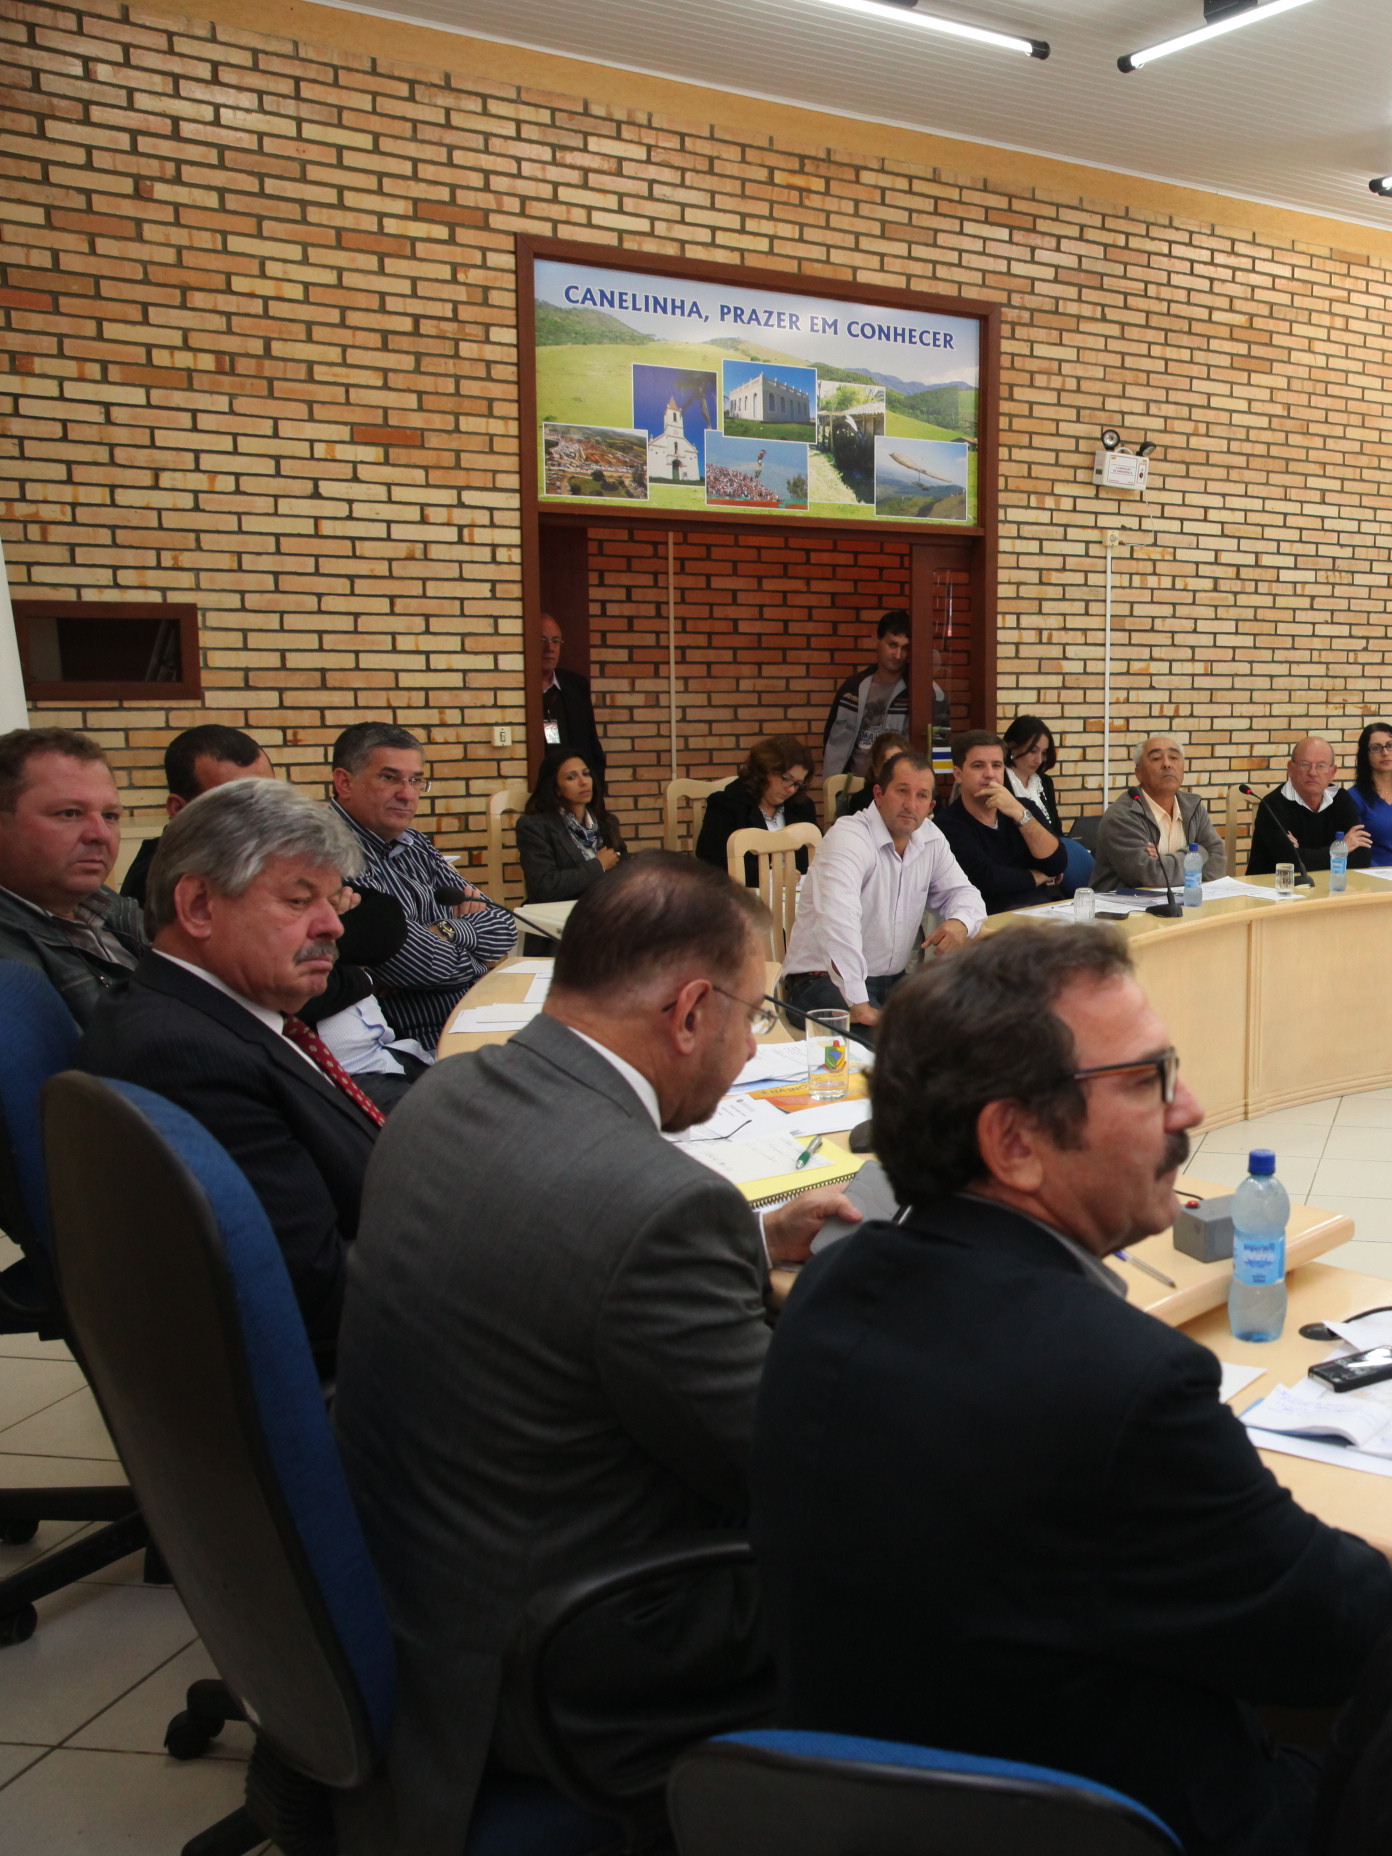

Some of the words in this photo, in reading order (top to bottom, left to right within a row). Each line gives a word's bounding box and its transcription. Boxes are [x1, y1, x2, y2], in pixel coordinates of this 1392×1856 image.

[564, 285, 710, 323] CANELINHA,
[719, 303, 802, 332] PRAZER
[809, 315, 839, 336] EM
[846, 320, 955, 350] CONHECER
